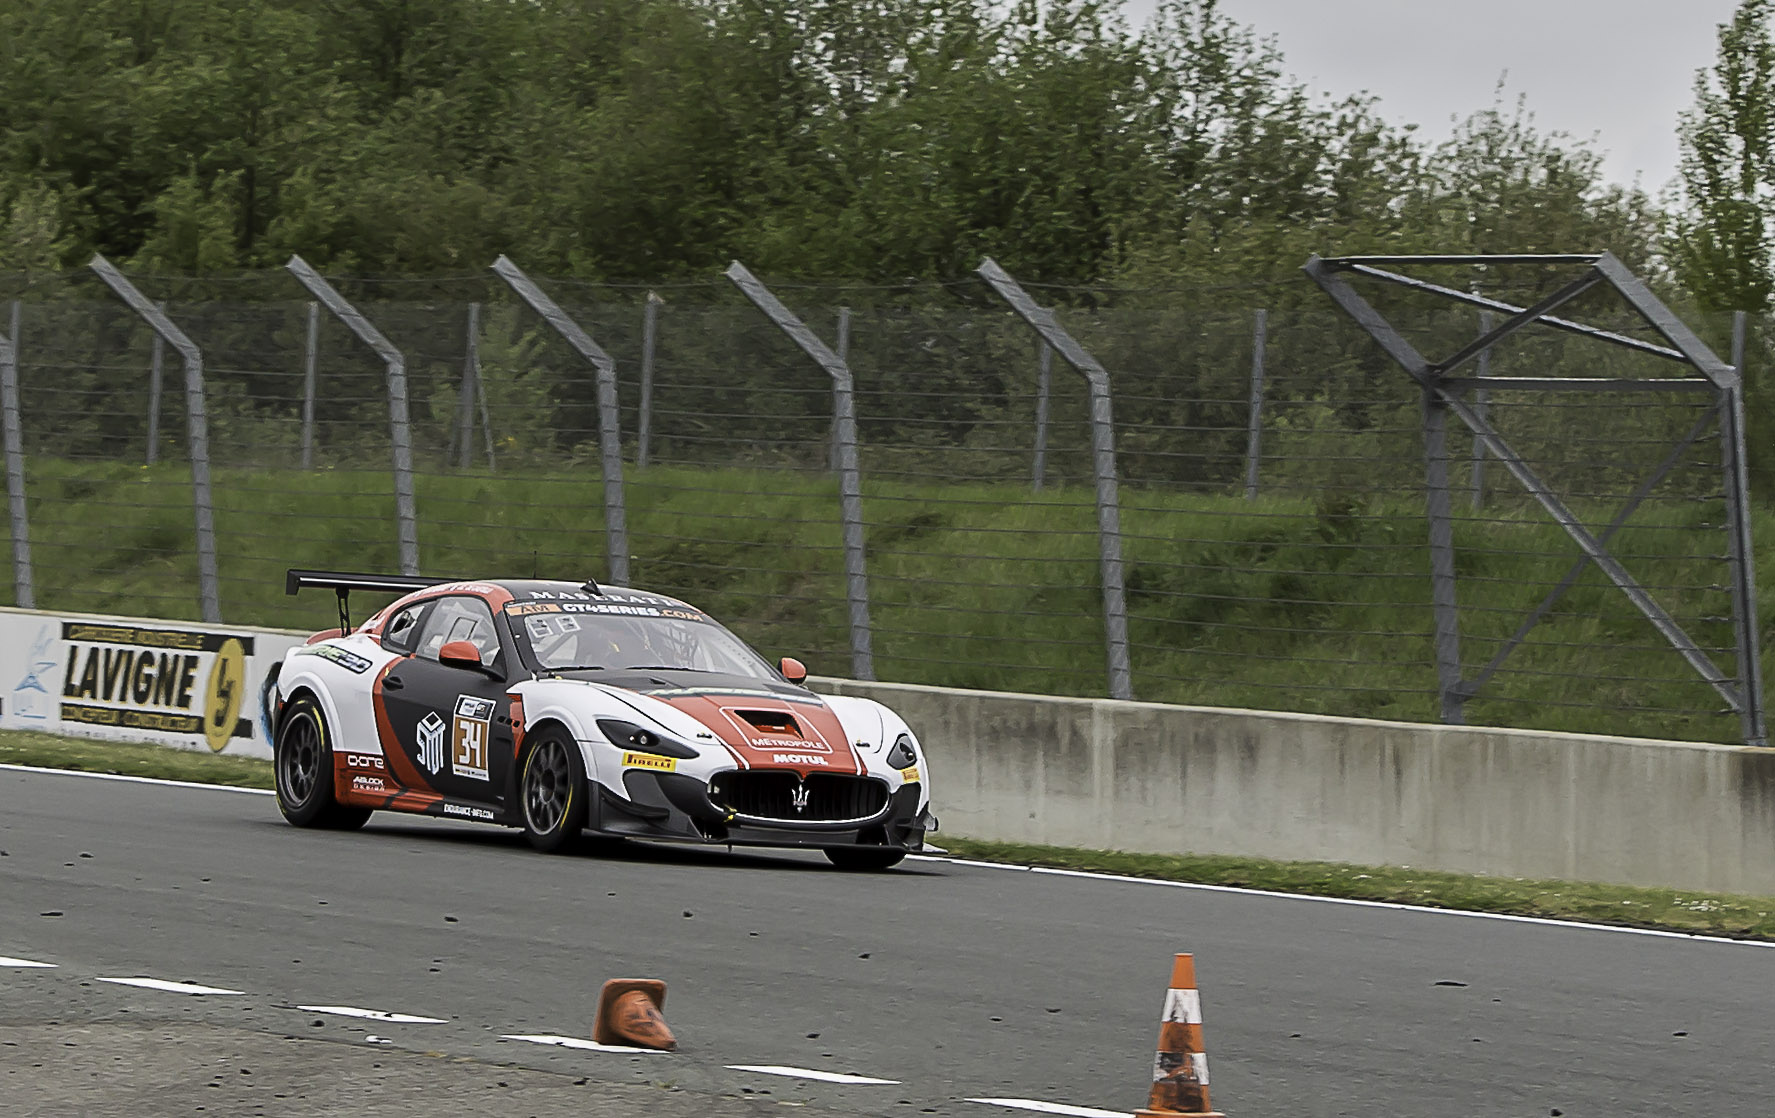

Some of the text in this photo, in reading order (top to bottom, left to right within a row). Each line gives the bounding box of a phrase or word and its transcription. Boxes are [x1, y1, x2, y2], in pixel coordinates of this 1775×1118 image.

[562, 603, 704, 622] GT4SERIES.COM
[63, 645, 200, 710] LAVIGNE
[458, 719, 482, 768] 34
[627, 753, 672, 768] PIRELLI
[773, 754, 829, 766] MOTUL
